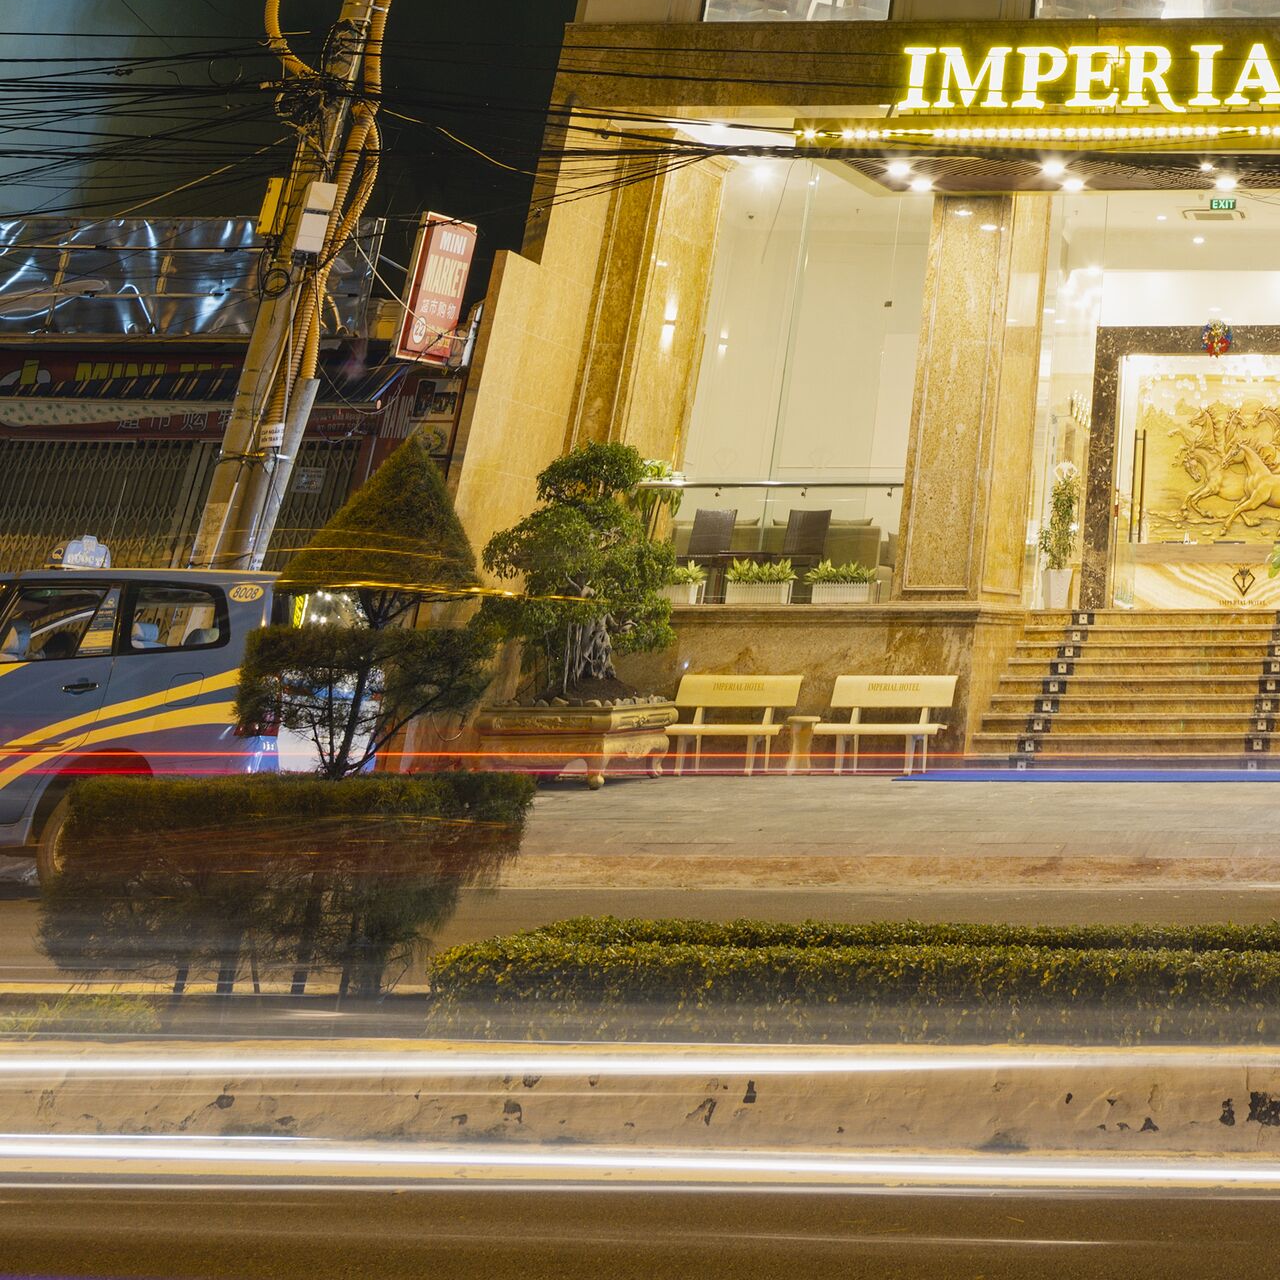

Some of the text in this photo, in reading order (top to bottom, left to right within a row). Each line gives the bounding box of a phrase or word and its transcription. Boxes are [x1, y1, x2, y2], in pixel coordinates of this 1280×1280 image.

[1212, 199, 1235, 209] EXIT
[439, 230, 469, 256] MINI
[422, 253, 470, 300] MARKET
[233, 587, 259, 599] 8008
[712, 682, 765, 691] IMPERIAL HOTEL
[867, 682, 920, 692] IMPERIAL HOTEL
